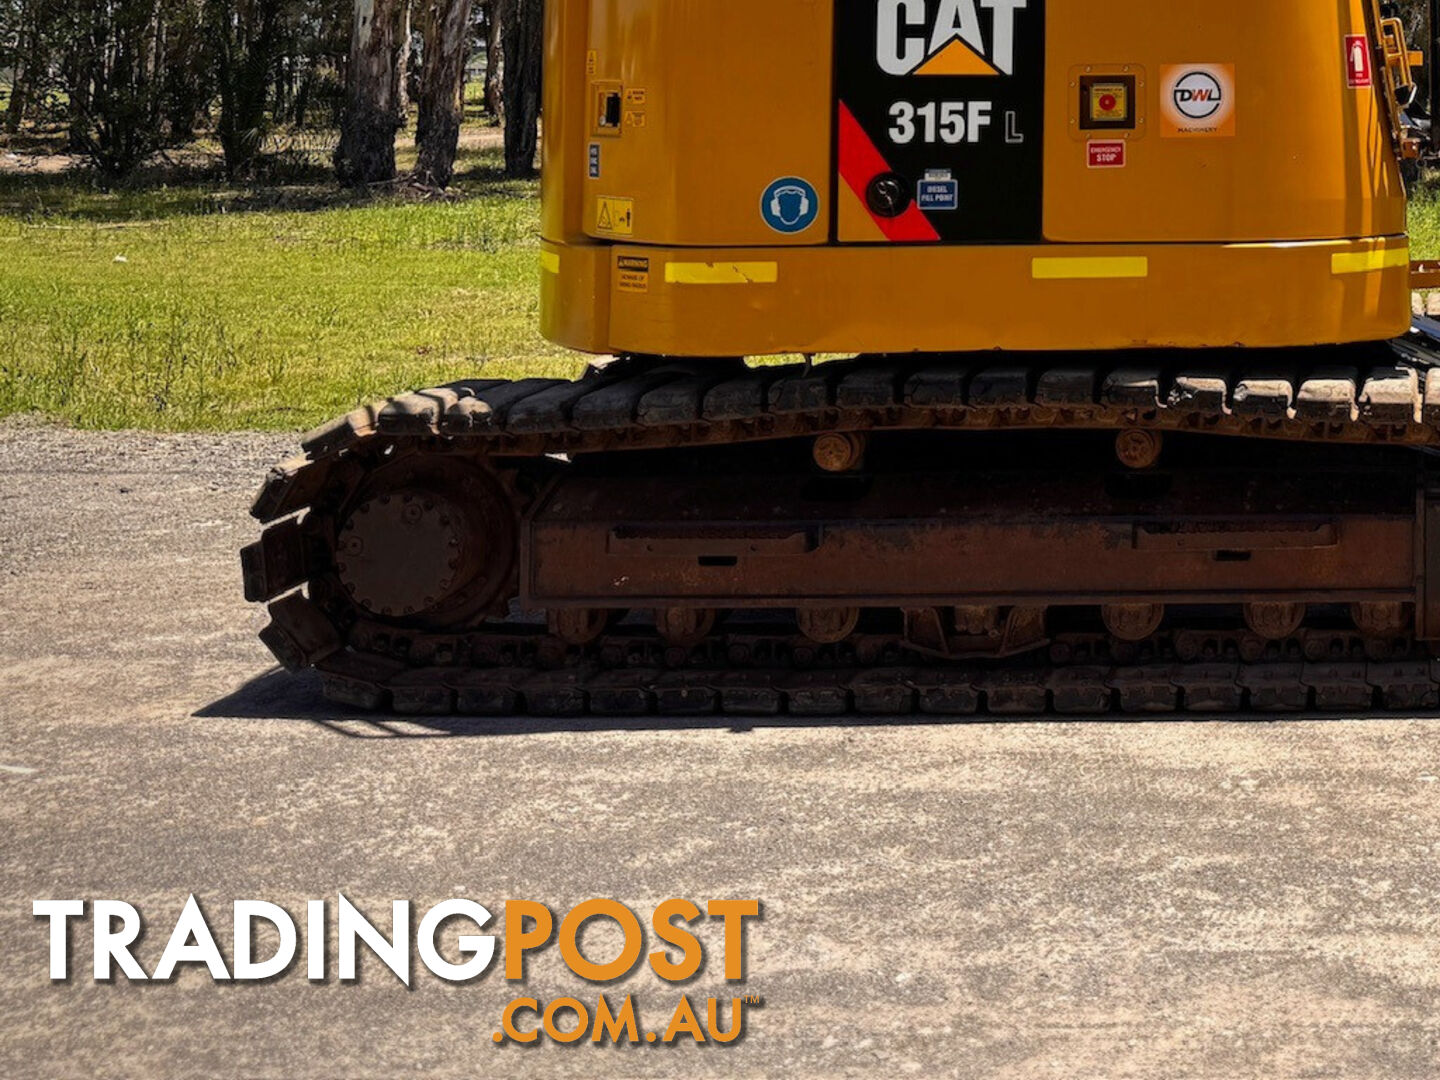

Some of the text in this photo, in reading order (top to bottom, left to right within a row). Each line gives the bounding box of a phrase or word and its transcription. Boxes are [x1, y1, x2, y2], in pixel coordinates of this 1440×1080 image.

[1174, 89, 1221, 102] DWL
[888, 101, 1024, 144] 315F L
[1096, 154, 1117, 162] STOP
[927, 185, 948, 193] DIESEL
